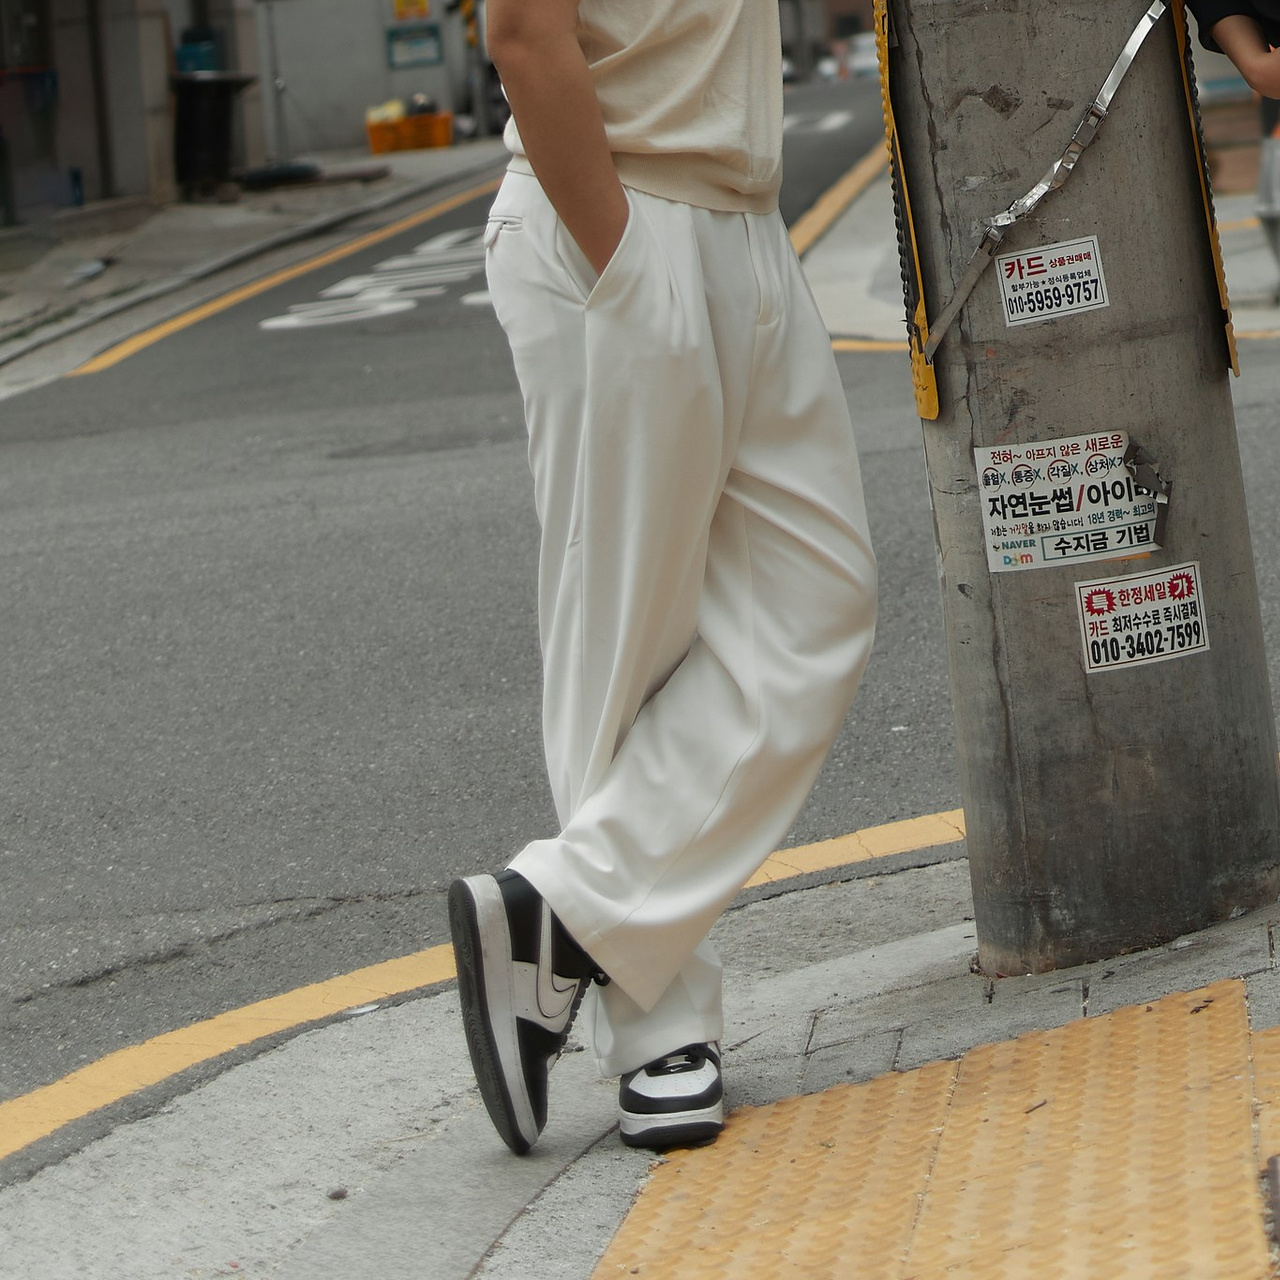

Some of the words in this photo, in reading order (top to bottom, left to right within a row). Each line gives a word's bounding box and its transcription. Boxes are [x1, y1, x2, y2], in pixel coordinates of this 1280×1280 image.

[1004, 256, 1048, 280] 카드
[1048, 251, 1092, 268] 상품권매매
[1011, 280, 1040, 293] 할부가능
[1047, 269, 1092, 285] 정식등록업체
[1025, 446, 1057, 461] 아프지
[1059, 442, 1082, 457] 않은
[1085, 434, 1124, 452] 새로운
[1087, 511, 1106, 525] 18년
[1132, 502, 1155, 517] 최고의
[1009, 521, 1035, 535] 거짓말을
[1036, 522, 1051, 532] 하지
[1054, 530, 1109, 556] 수지금
[1116, 523, 1151, 545] 기법
[1001, 539, 1036, 550] NAVER
[1091, 593, 1108, 611] 특
[1117, 581, 1167, 607] 한정세일
[1173, 578, 1189, 596] 가
[1088, 620, 1110, 638] 카드
[1112, 609, 1162, 633] 최저수수료
[1163, 600, 1199, 623] 즉시결제
[1090, 620, 1201, 664] 010-3402-7599
